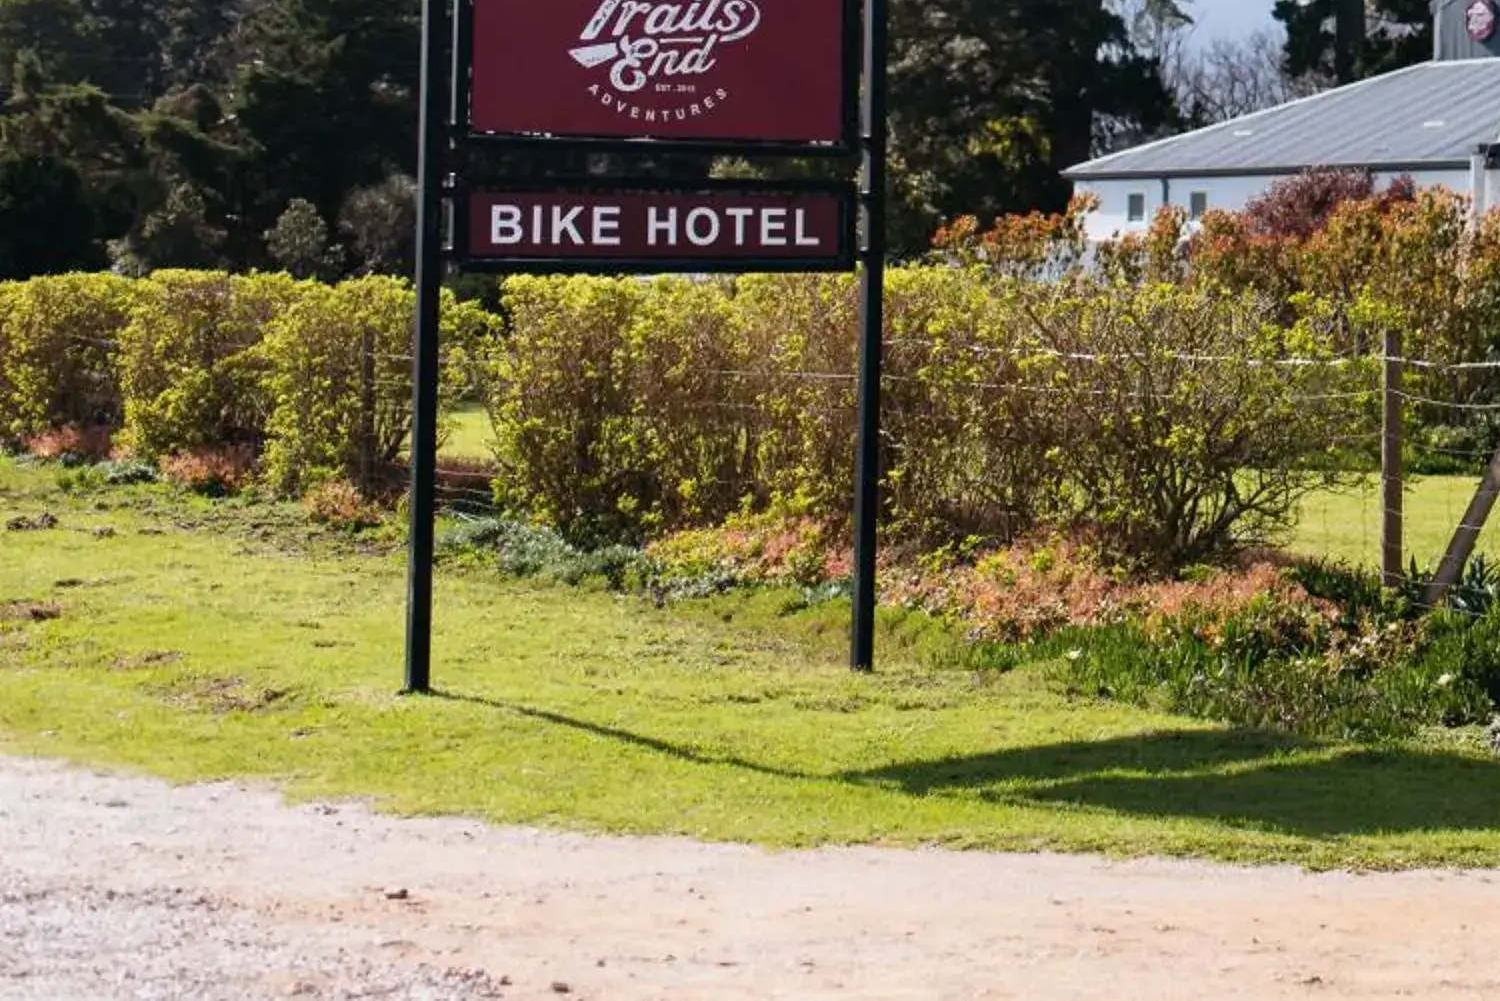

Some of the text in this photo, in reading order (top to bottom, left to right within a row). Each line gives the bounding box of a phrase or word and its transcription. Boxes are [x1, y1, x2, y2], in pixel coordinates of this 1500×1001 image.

[610, 34, 717, 92] End
[588, 83, 727, 121] ADVENTURES
[490, 204, 820, 246] BIKE HOTEL
